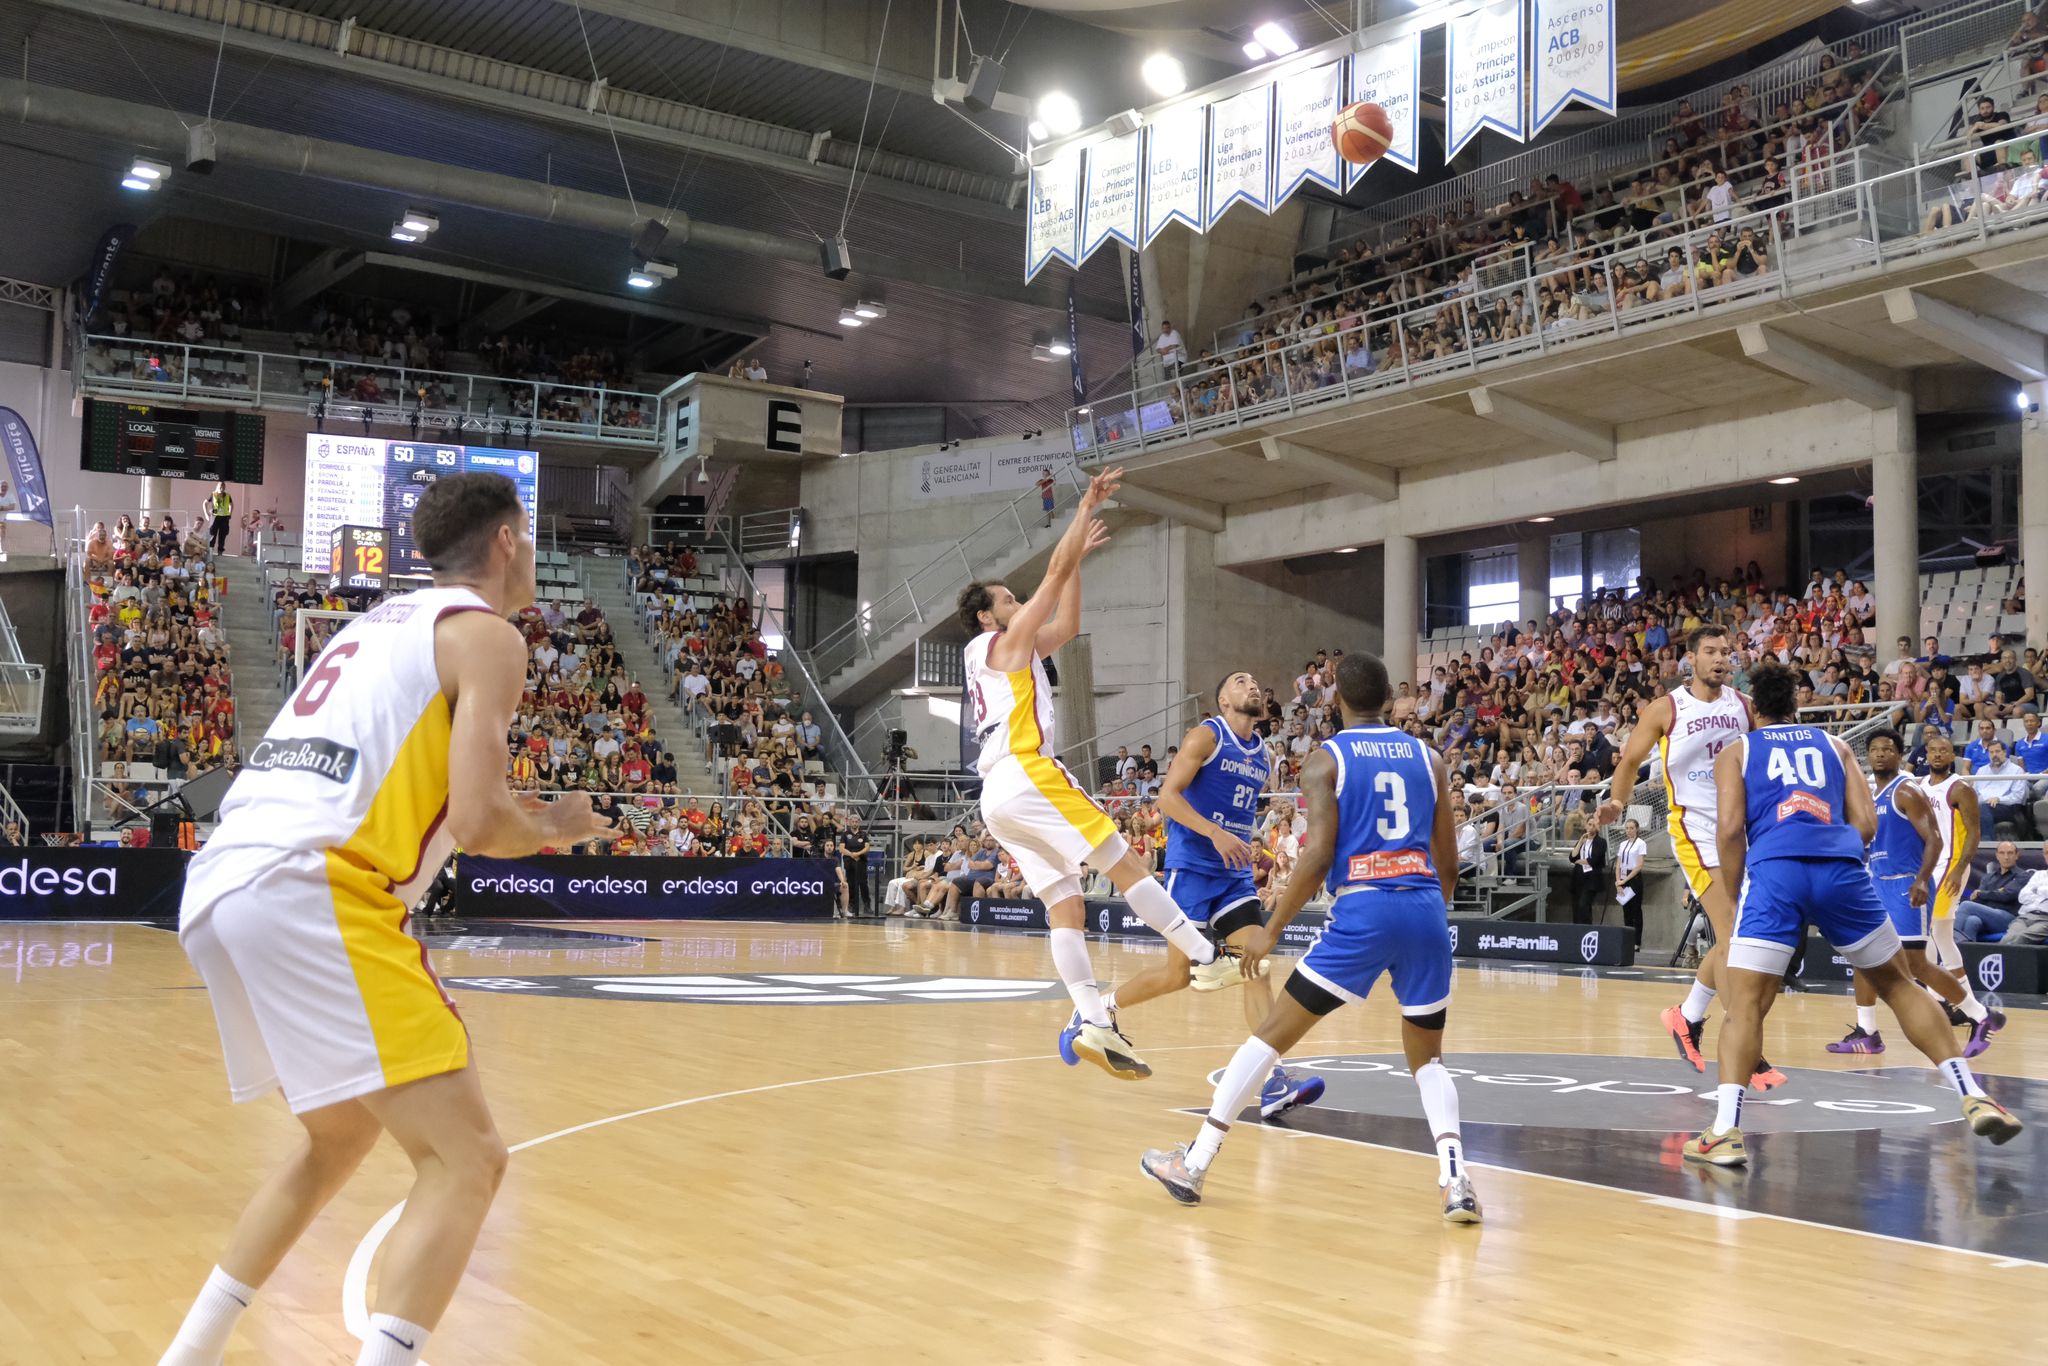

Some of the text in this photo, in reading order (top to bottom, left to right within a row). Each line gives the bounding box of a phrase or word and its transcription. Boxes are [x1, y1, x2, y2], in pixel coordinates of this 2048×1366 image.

[1548, 3, 1603, 29] Ascenso
[1548, 28, 1580, 53] ACB
[1548, 40, 1604, 67] 2008/09
[1455, 67, 1516, 94] de Asturias
[1359, 89, 1376, 102] Liga
[1379, 93, 1408, 108] nciana
[1455, 83, 1515, 111] 2008/09
[1286, 120, 1302, 132] Liga
[1285, 125, 1332, 145] Valenciana
[1218, 142, 1233, 154] Liga
[1217, 148, 1262, 166] Valenciana
[1102, 162, 1135, 178] Campeón
[1153, 159, 1172, 176] LEB
[1181, 168, 1198, 182] ACB
[1217, 162, 1261, 182] 2002/03
[1035, 199, 1051, 214] LEB
[1090, 190, 1134, 209] de Asturias
[1059, 209, 1073, 222] ACB
[129, 424, 156, 432] LOCAL
[767, 400, 801, 452] E
[195, 430, 220, 439] VISITANTE
[336, 444, 375, 456] ESPAÑA
[394, 446, 414, 462] 50
[437, 450, 455, 465] 53
[471, 456, 515, 466] DOMINICANA
[934, 462, 981, 474] GENERALITAT
[998, 457, 1021, 466] CENTRE
[1018, 464, 1053, 474] ESPORTIVA
[934, 473, 979, 484] VALENCIANA
[352, 530, 382, 542] 5:26
[398, 528, 405, 536] 0
[355, 546, 383, 573] 12
[400, 549, 424, 559] 1 FAL
[349, 579, 381, 587] LOTUS
[293, 641, 360, 716] 6
[1687, 714, 1740, 736] ESPAÑA
[1763, 730, 1812, 742] SANTOS
[1350, 741, 1414, 759] MONTERO
[250, 742, 348, 778] CaxaBank
[1767, 746, 1826, 789] 40
[1221, 759, 1267, 782] DOMINICANA
[1233, 784, 1254, 809] 27
[1374, 771, 1410, 840] 3
[471, 874, 824, 895] endesa endesa endesa endesa
[1282, 924, 1308, 932] LECCIÓN
[1478, 934, 1558, 951] #LaFamilia
[1846, 968, 1854, 976] D
